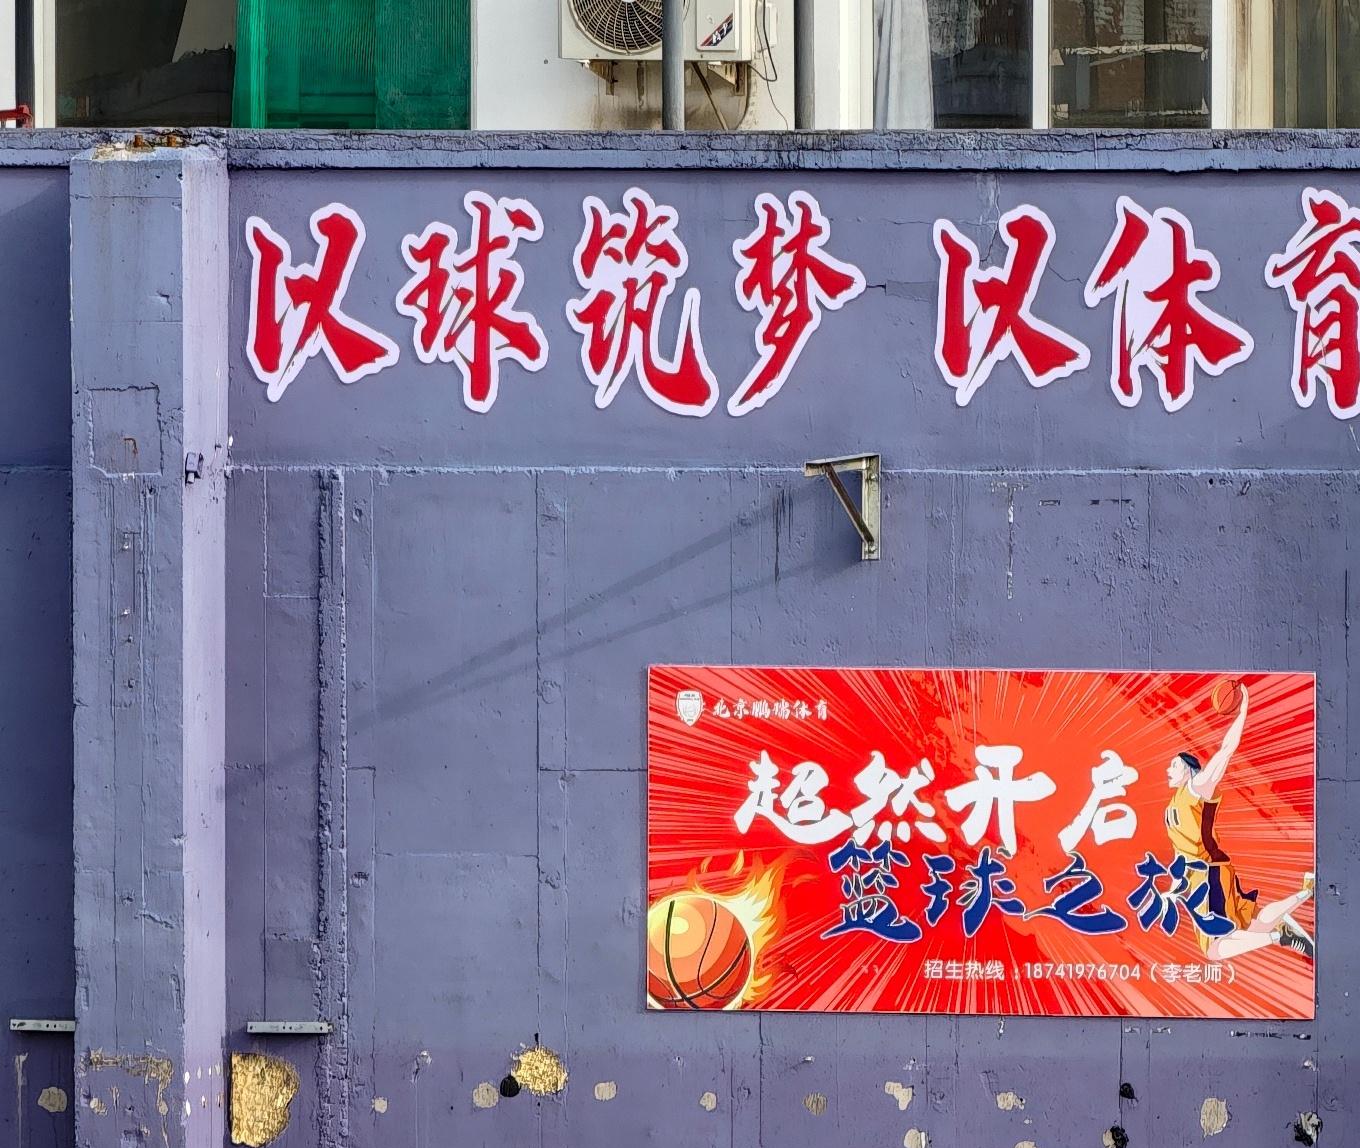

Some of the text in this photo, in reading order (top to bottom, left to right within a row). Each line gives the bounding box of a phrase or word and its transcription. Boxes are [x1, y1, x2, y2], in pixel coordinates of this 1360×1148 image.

[245, 188, 866, 418] 以球筑梦
[734, 745, 1139, 853] 超然开启
[819, 838, 1237, 943] 篮球之旅
